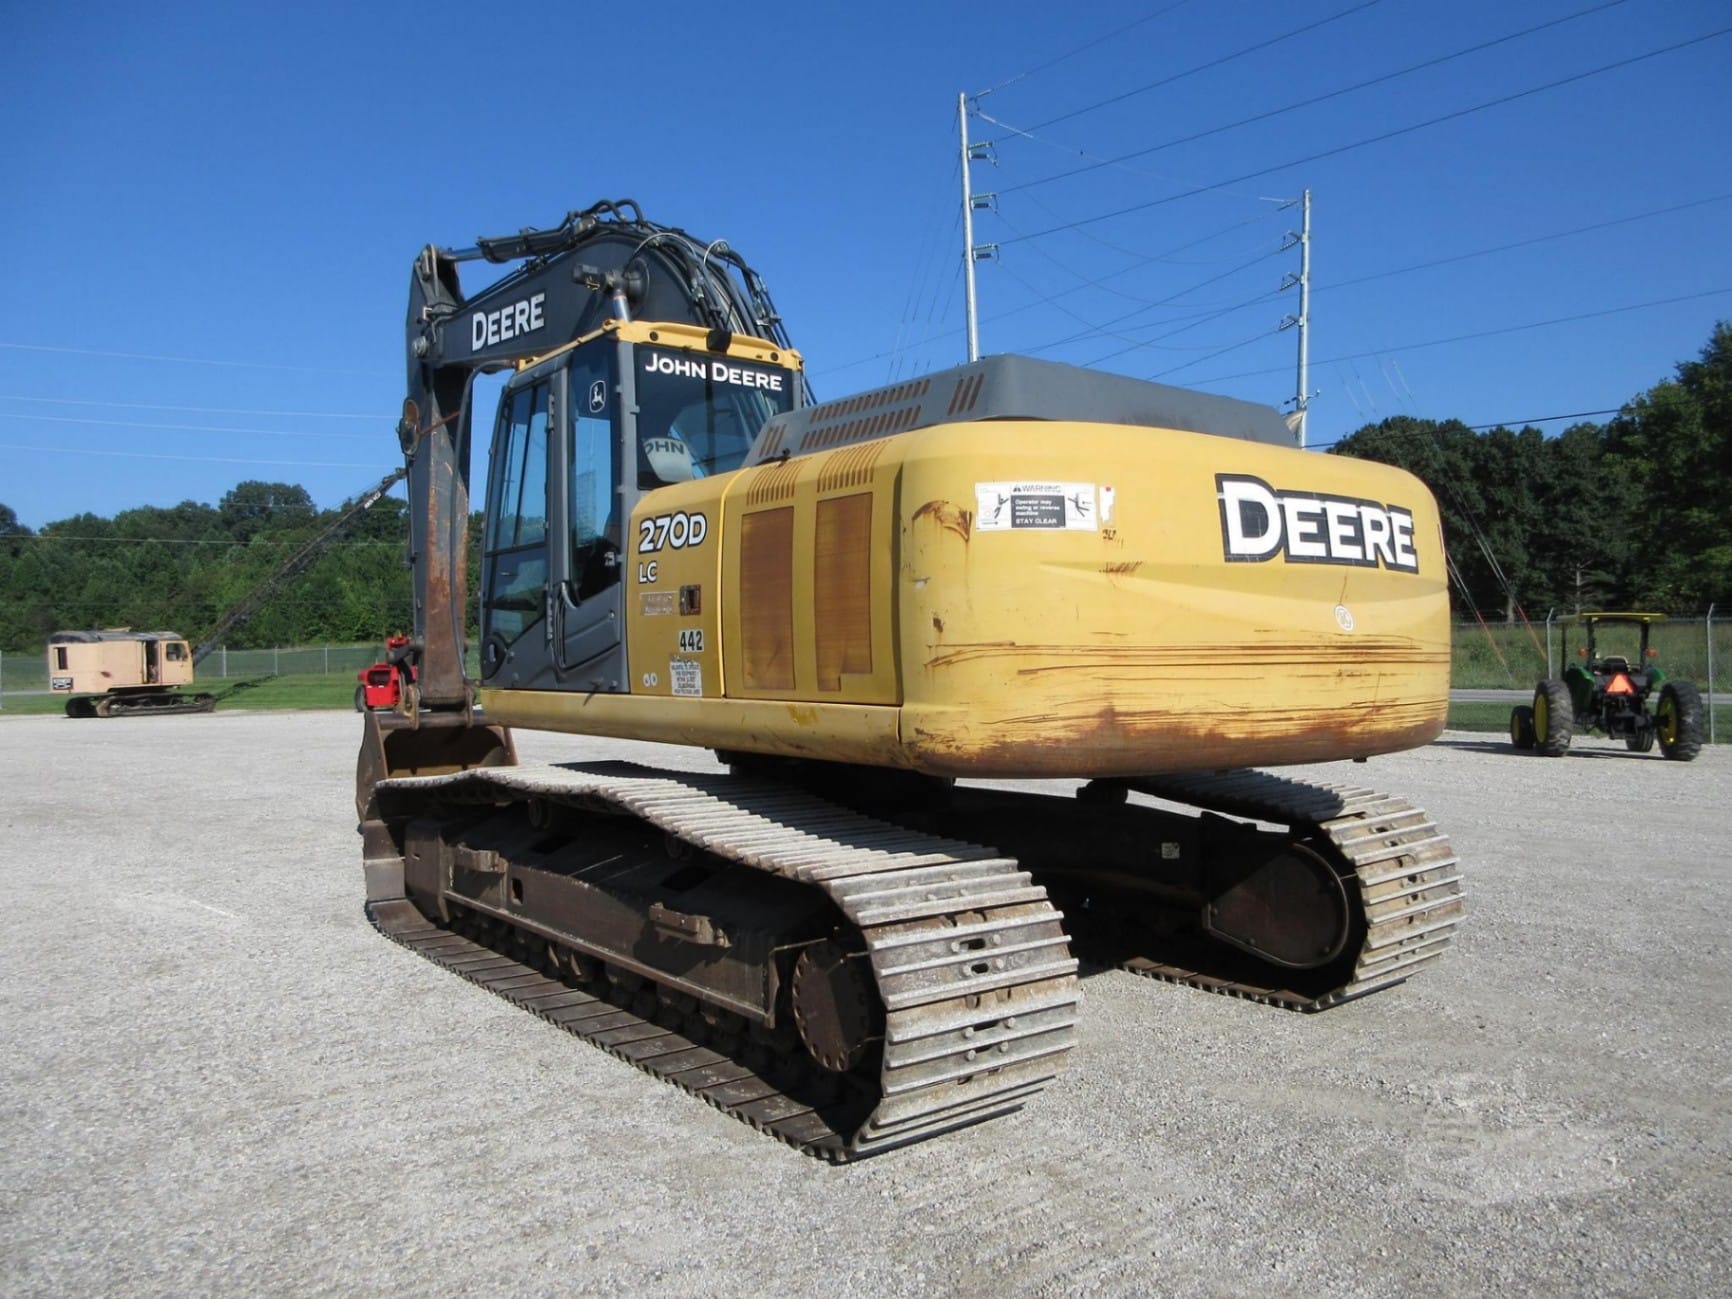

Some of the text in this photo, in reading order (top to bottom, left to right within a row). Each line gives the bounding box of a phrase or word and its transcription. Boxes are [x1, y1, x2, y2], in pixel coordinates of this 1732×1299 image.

[472, 293, 545, 352] DEERE
[645, 353, 783, 391] JOHN DEERE
[639, 511, 707, 553] 270D
[1215, 473, 1419, 574] DEERE
[639, 562, 658, 583] LC
[680, 630, 703, 651] 442
